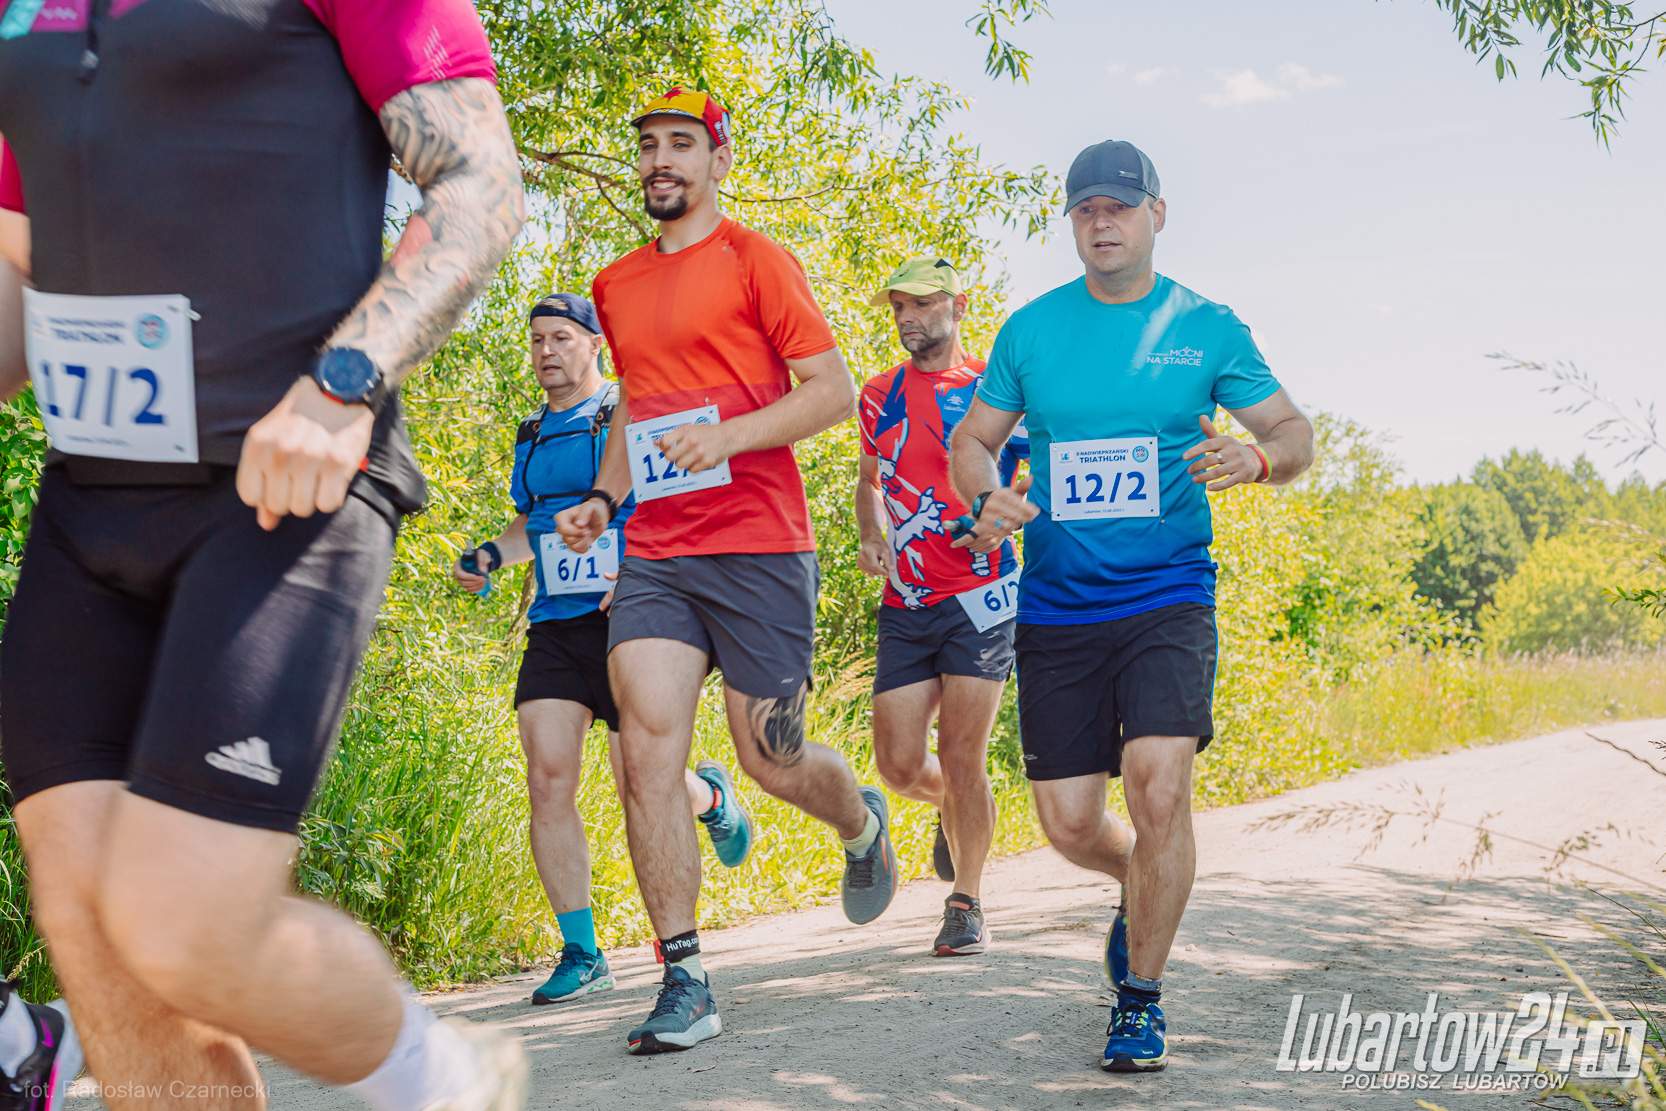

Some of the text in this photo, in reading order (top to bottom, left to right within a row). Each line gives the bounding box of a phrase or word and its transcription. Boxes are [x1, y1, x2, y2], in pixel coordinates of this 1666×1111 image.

[1146, 356, 1202, 366] NA STARCIE
[1080, 455, 1126, 463] TRIATHLON
[1065, 471, 1147, 504] 12/2
[558, 557, 599, 581] 6/1
